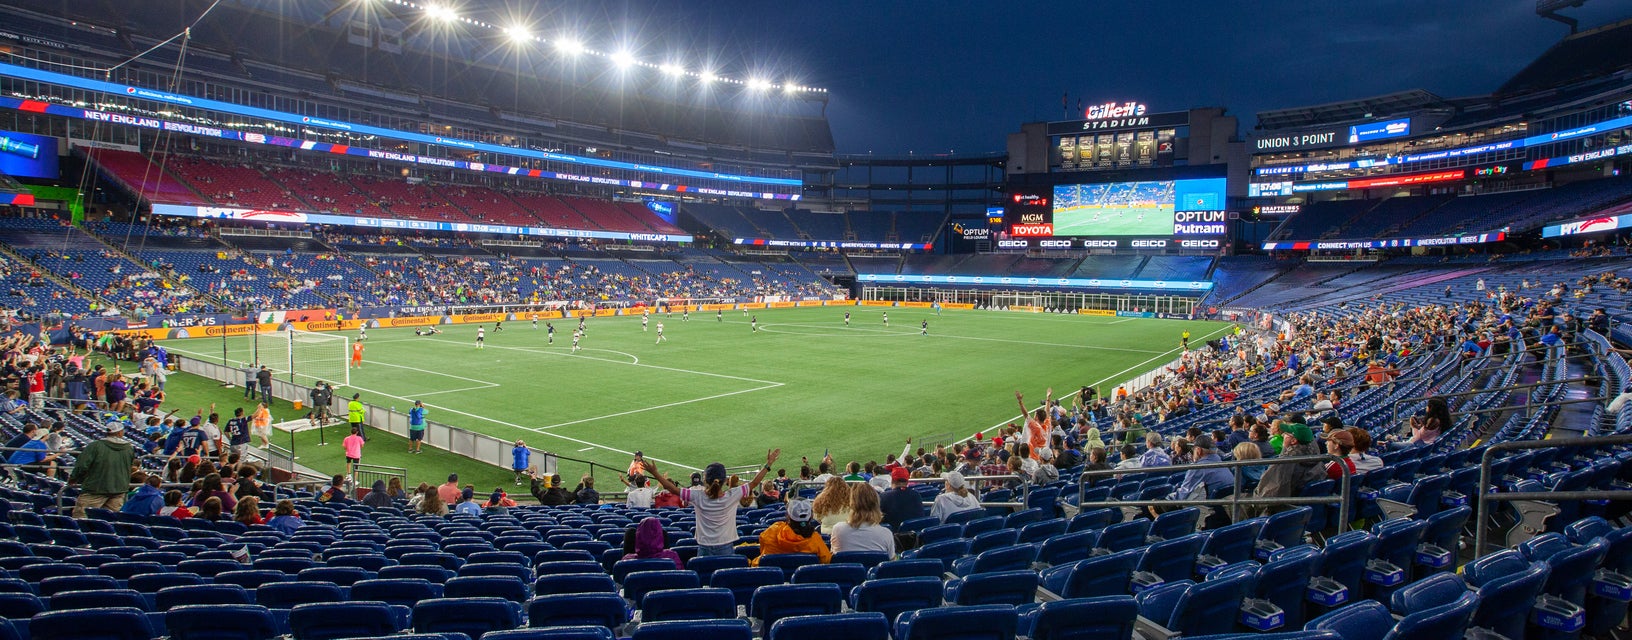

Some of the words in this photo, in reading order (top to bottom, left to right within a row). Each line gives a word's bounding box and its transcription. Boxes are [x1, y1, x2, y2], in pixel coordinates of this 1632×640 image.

[1086, 101, 1147, 120] Gillette
[84, 110, 110, 121] NEW
[111, 114, 160, 128] ENGLAND
[163, 121, 222, 137] REVOLUTION
[1083, 117, 1149, 130] STADIUM
[1257, 136, 1290, 149] UNION
[1302, 132, 1336, 146] POINT
[369, 150, 385, 158] NEW
[385, 152, 416, 162] ENGLAND
[418, 155, 455, 167] REVOLUTION
[1568, 154, 1585, 163] NEW
[1585, 148, 1615, 160] ENGLAND
[1475, 167, 1493, 176] Party
[1493, 165, 1507, 175] City
[568, 174, 590, 182] ENGLAND
[1021, 213, 1044, 222] MGM
[1174, 210, 1225, 222] OPTUM
[963, 228, 989, 236] OPTUM
[1013, 226, 1052, 235] TOYOTA
[1174, 223, 1225, 234] Putnam
[630, 233, 667, 242] WHITECAPS
[306, 320, 347, 331] Continenal
[390, 317, 426, 327] Continental
[205, 324, 255, 336] Continental
